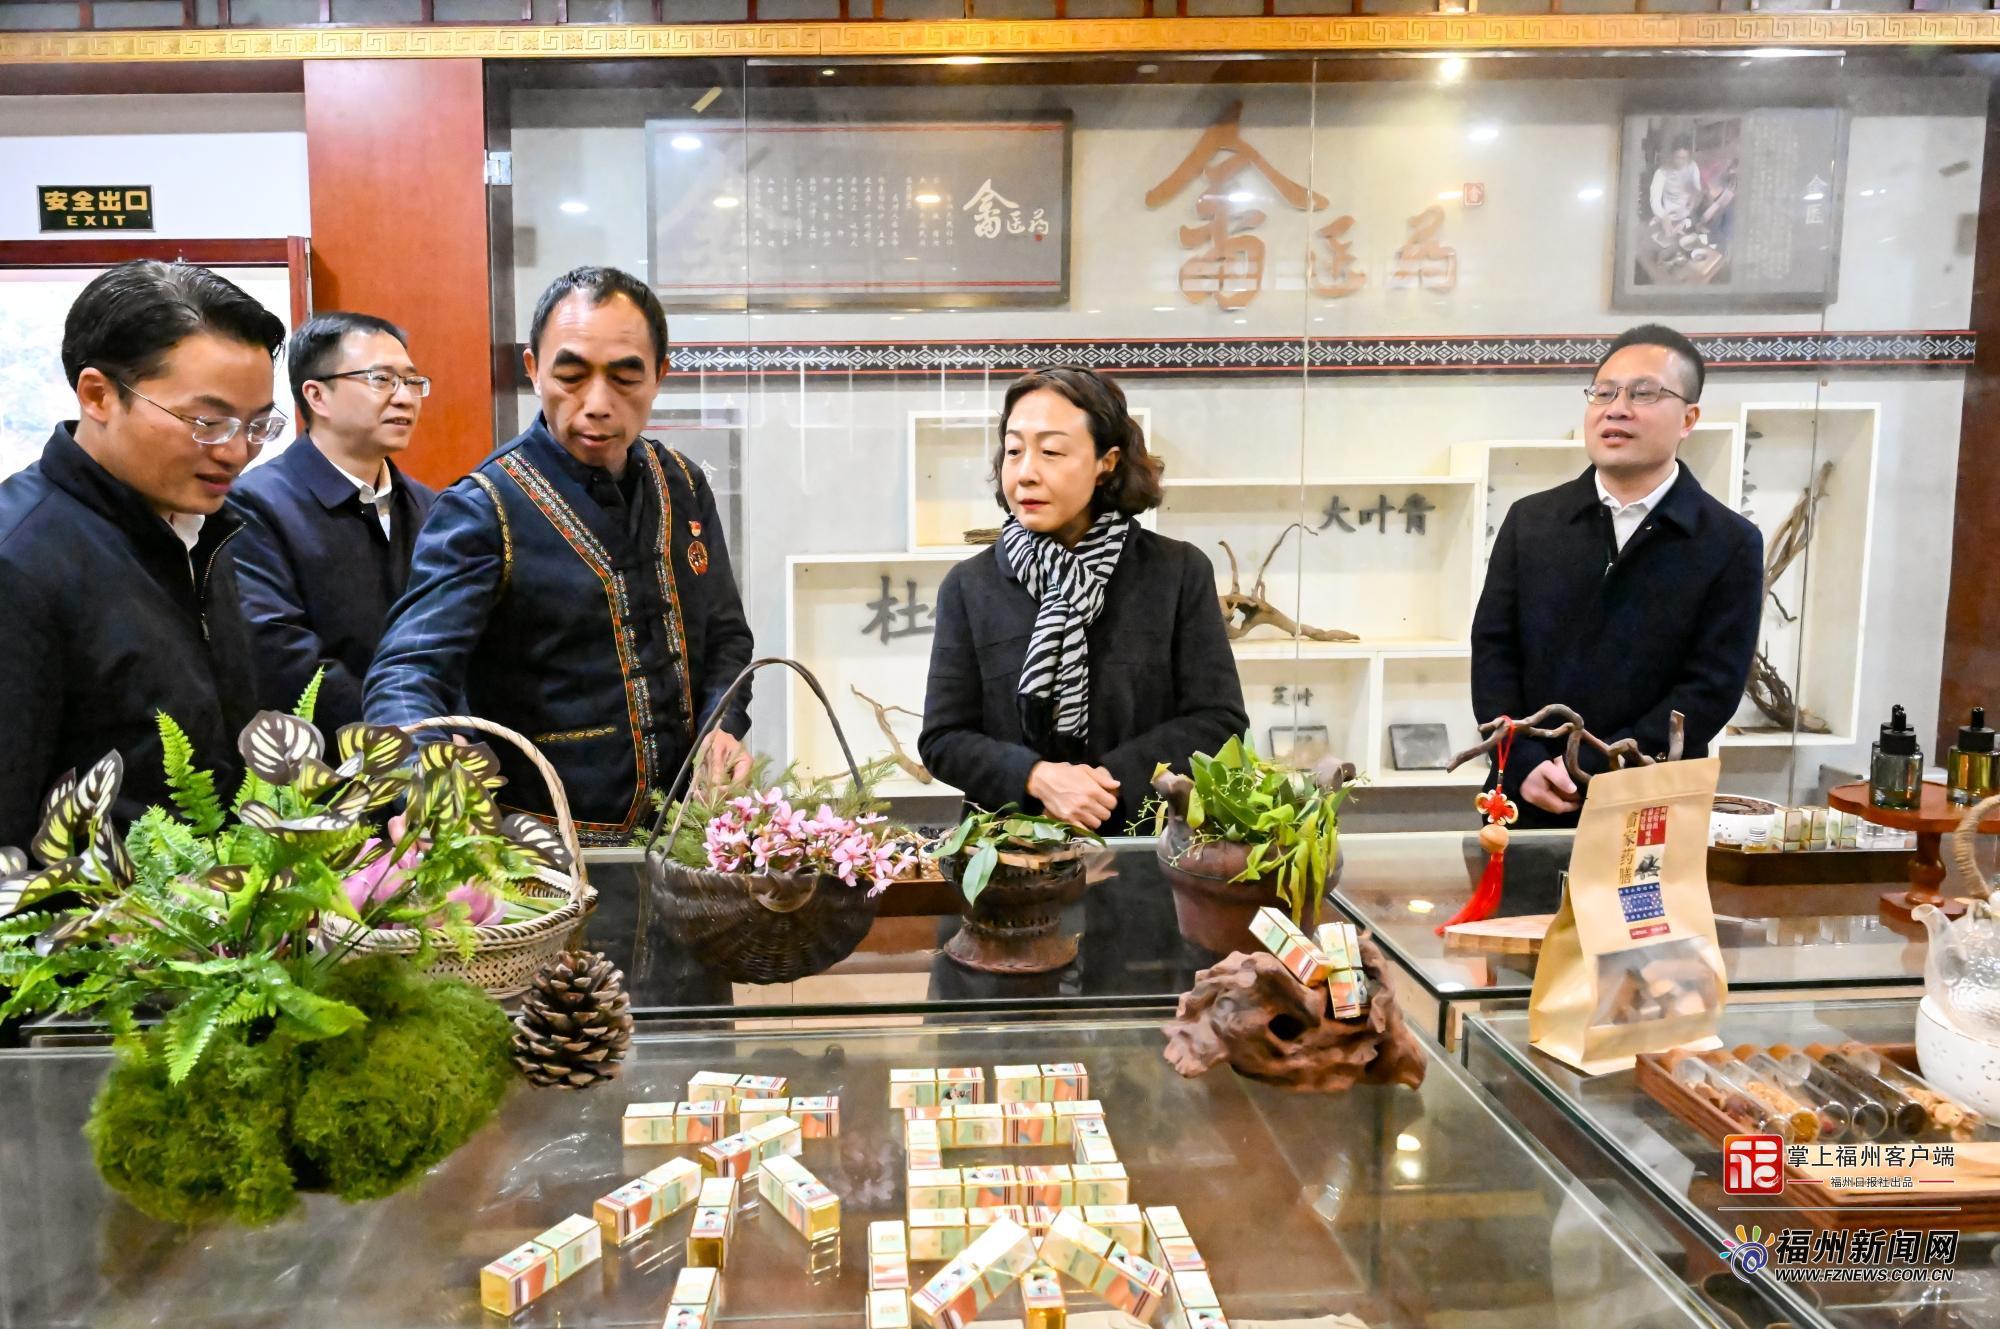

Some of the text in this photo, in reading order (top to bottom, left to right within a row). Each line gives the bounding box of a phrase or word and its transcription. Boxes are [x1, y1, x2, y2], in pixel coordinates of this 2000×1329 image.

[44, 189, 148, 212] 安全出口
[66, 214, 127, 227] EXIT
[1318, 492, 1436, 536] 大叶青
[861, 575, 936, 645] 杜
